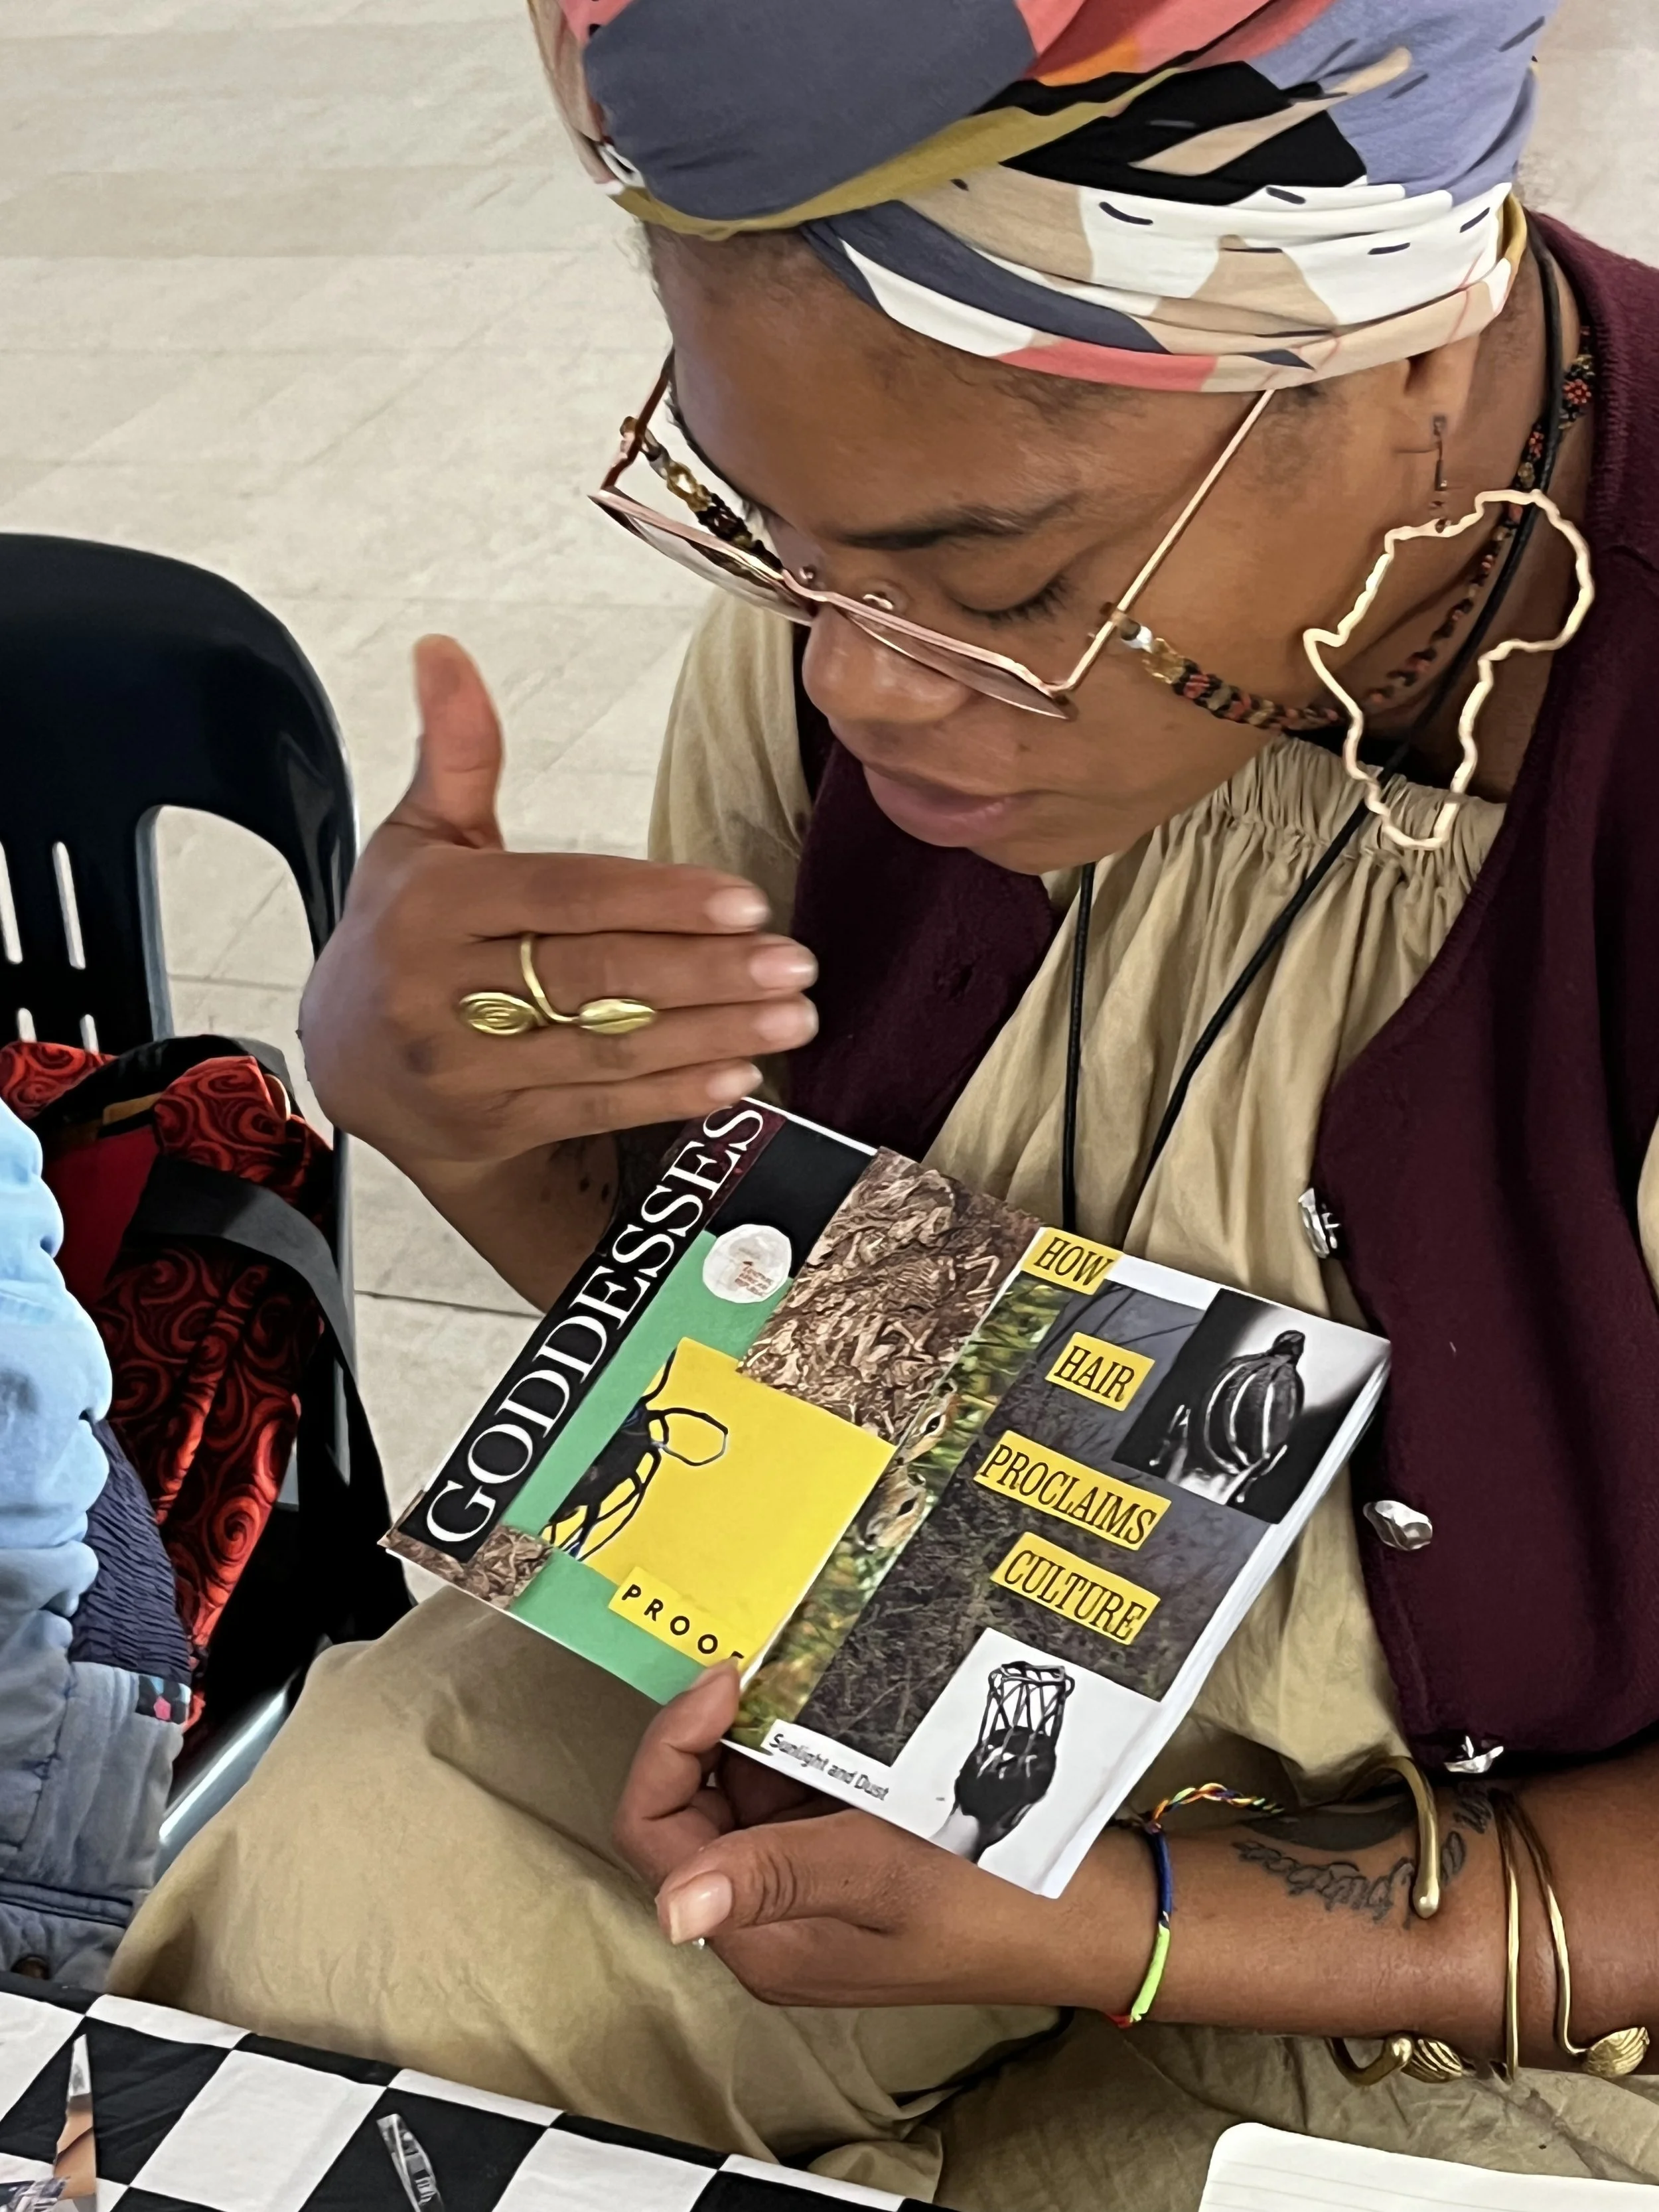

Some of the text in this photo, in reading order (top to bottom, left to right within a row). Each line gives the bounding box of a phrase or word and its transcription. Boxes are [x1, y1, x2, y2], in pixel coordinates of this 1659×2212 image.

[1033, 1236, 1116, 1286] HOW
[427, 1106, 764, 1542] GODDESSES
[1053, 1345, 1135, 1402] HAIR
[980, 1444, 1157, 1545] PROCLAIMS
[1004, 1550, 1147, 1641] CULTURE
[828, 1765, 858, 1785] and
[854, 1774, 889, 1801] Dust
